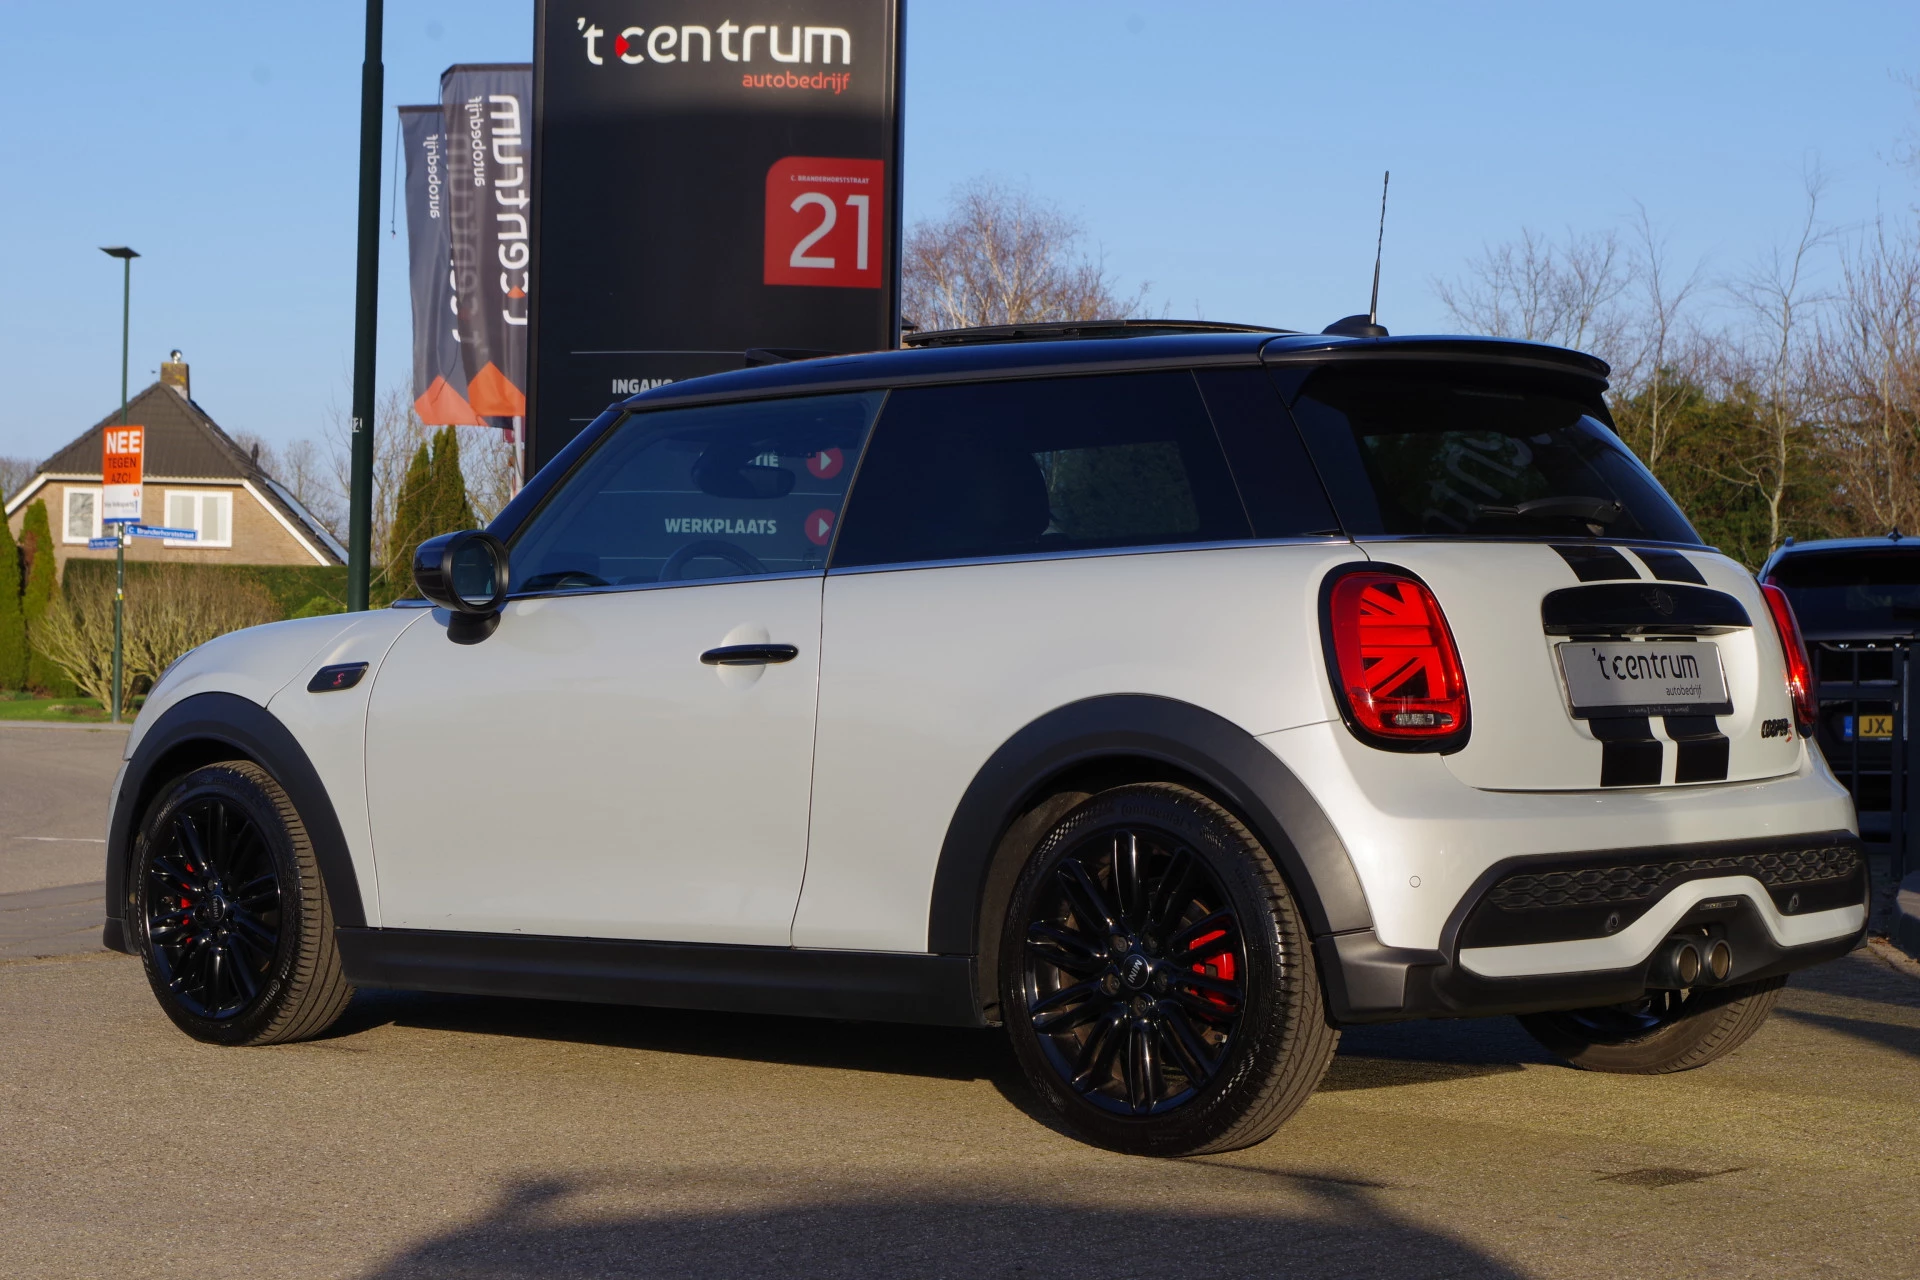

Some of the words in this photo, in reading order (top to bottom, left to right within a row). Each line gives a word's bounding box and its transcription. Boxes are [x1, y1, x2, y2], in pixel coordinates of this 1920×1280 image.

[614, 19, 851, 65] centrum
[742, 71, 851, 94] autobedrijf
[797, 175, 870, 184] BRANDERHORSTSTRAAT
[789, 191, 870, 270] 21
[106, 430, 142, 454] NEE
[108, 457, 137, 469] TEGEN
[111, 473, 132, 484] AZC!
[664, 518, 777, 535] WERKPLAATS
[1612, 651, 1700, 681] centrum
[1665, 684, 1702, 699] autobedrijf
[1128, 959, 1143, 984] MINI
